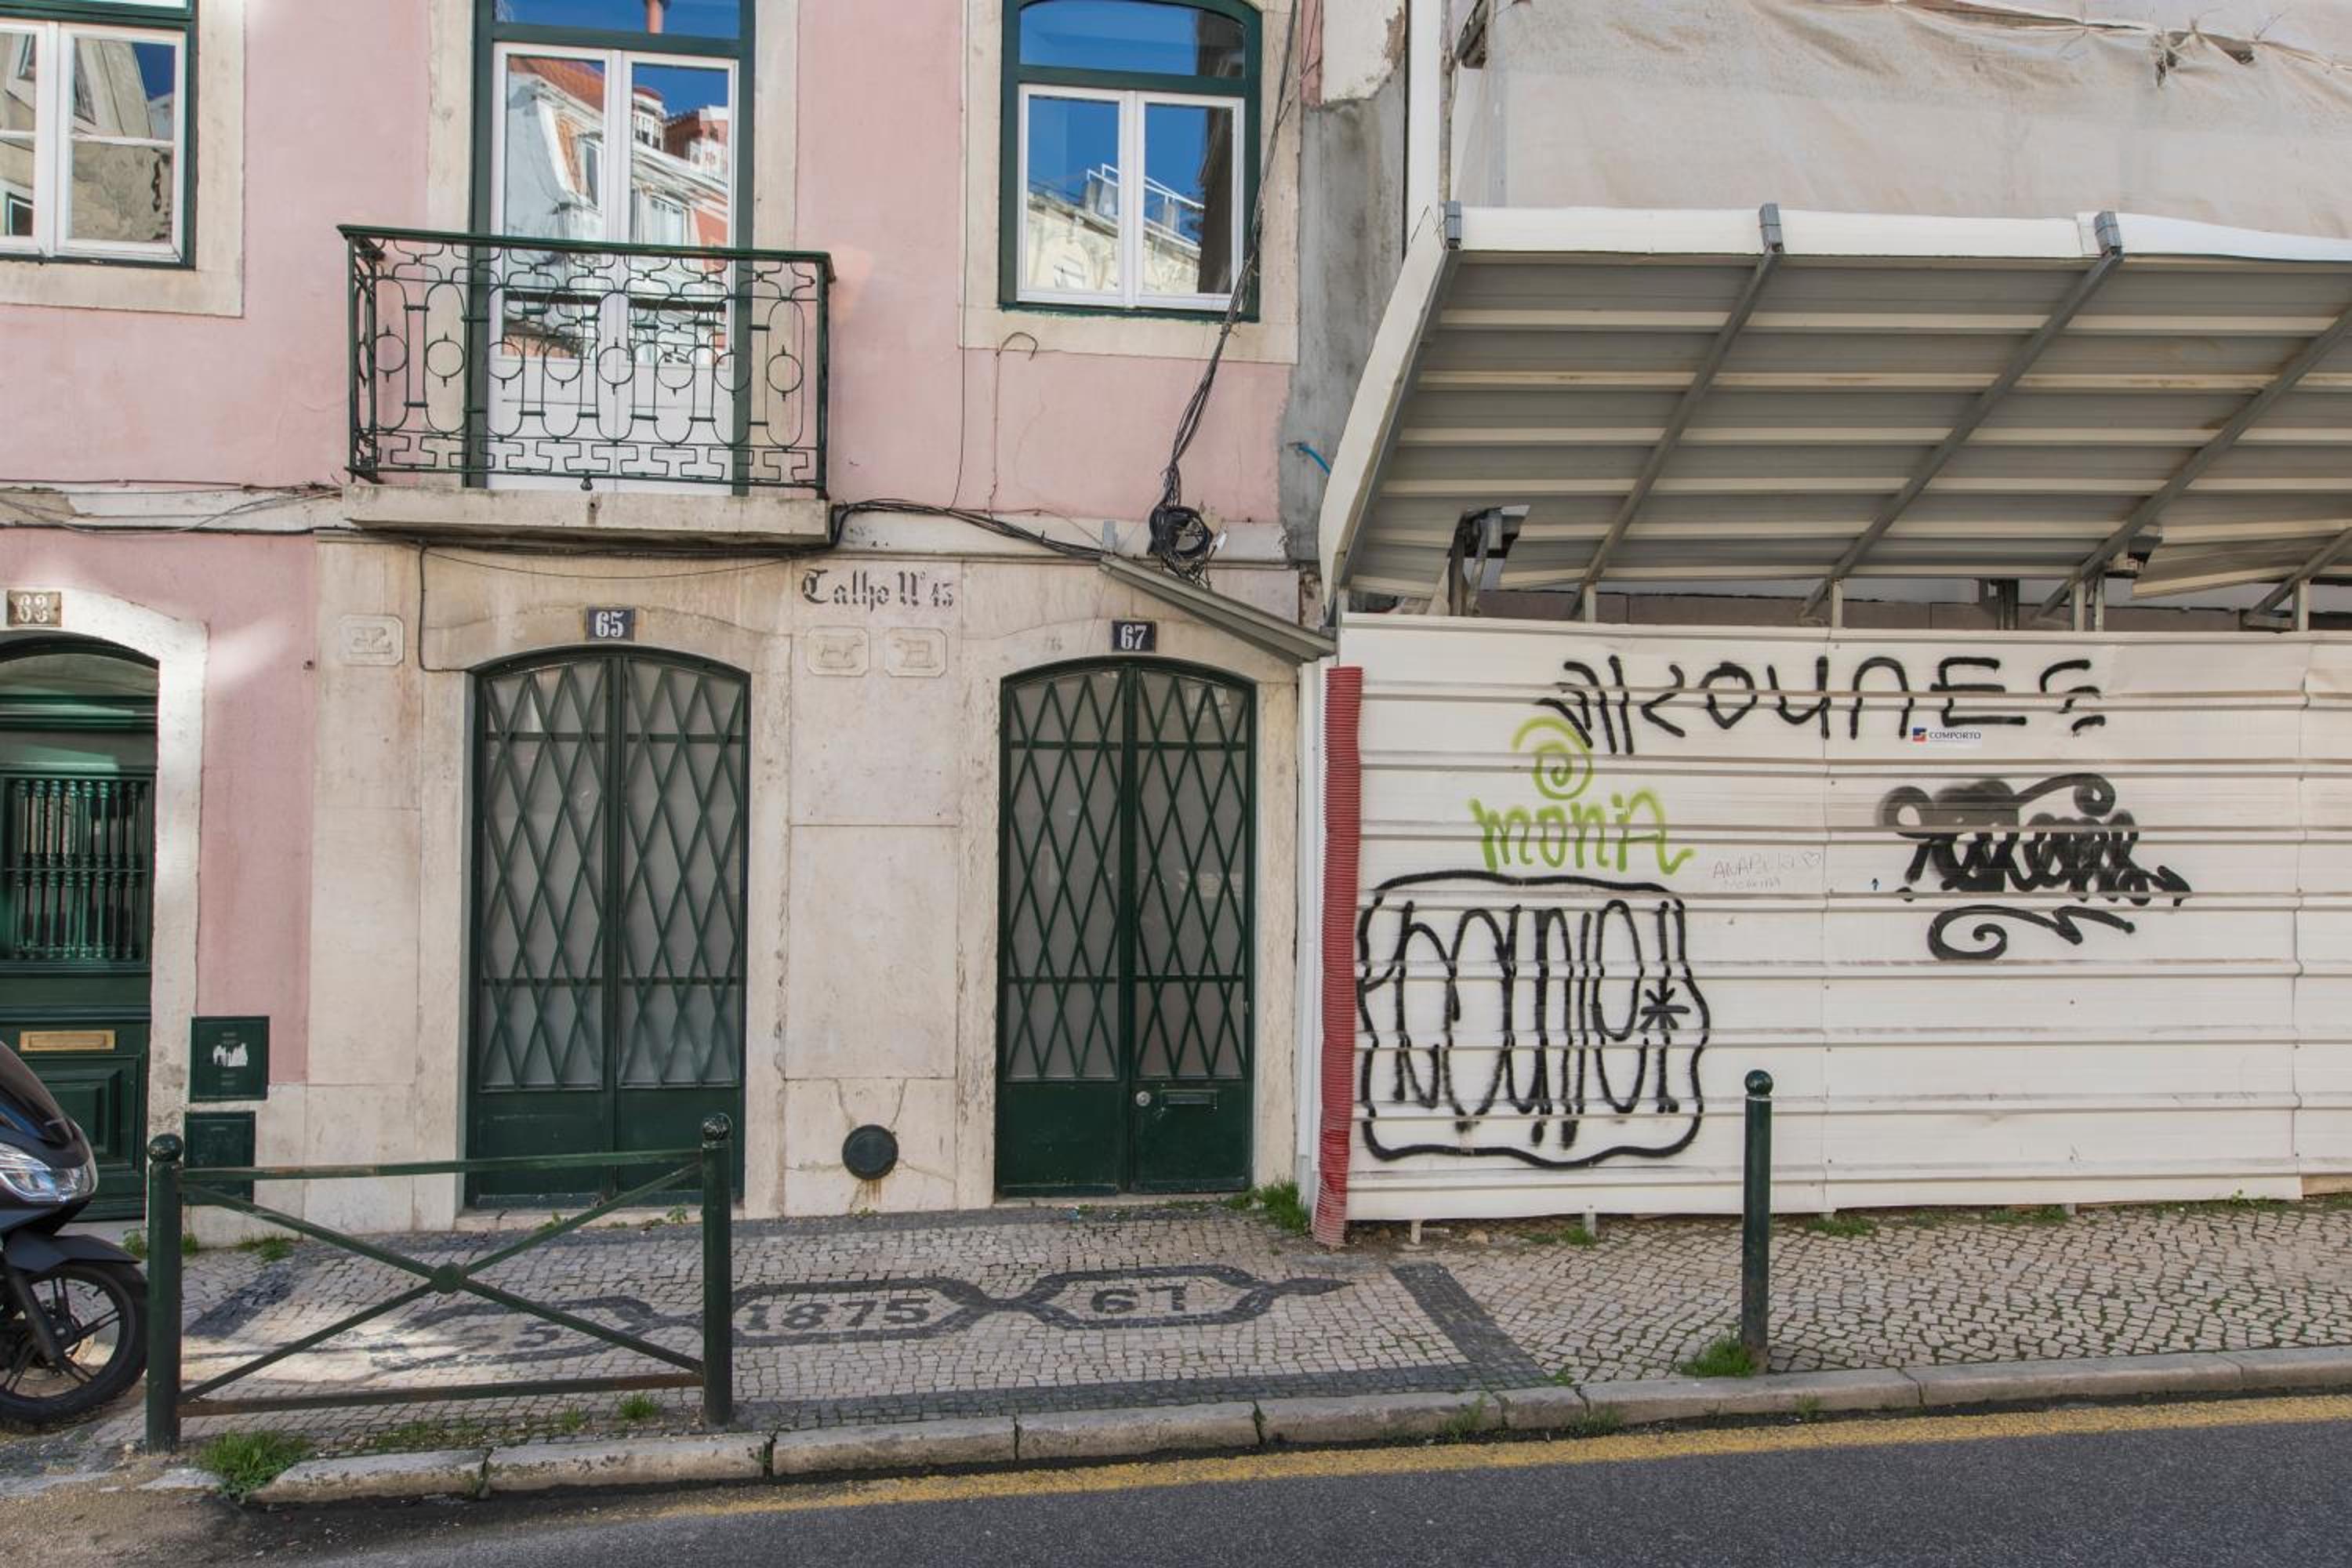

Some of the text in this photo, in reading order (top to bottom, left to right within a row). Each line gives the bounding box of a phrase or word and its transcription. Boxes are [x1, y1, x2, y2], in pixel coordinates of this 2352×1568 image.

[18, 593, 49, 623] 63
[596, 611, 625, 638] 65
[1120, 624, 1148, 651] 67
[1929, 731, 1982, 740] COMPORTO
[746, 1298, 931, 1330] 1875
[1091, 1283, 1187, 1315] 67
